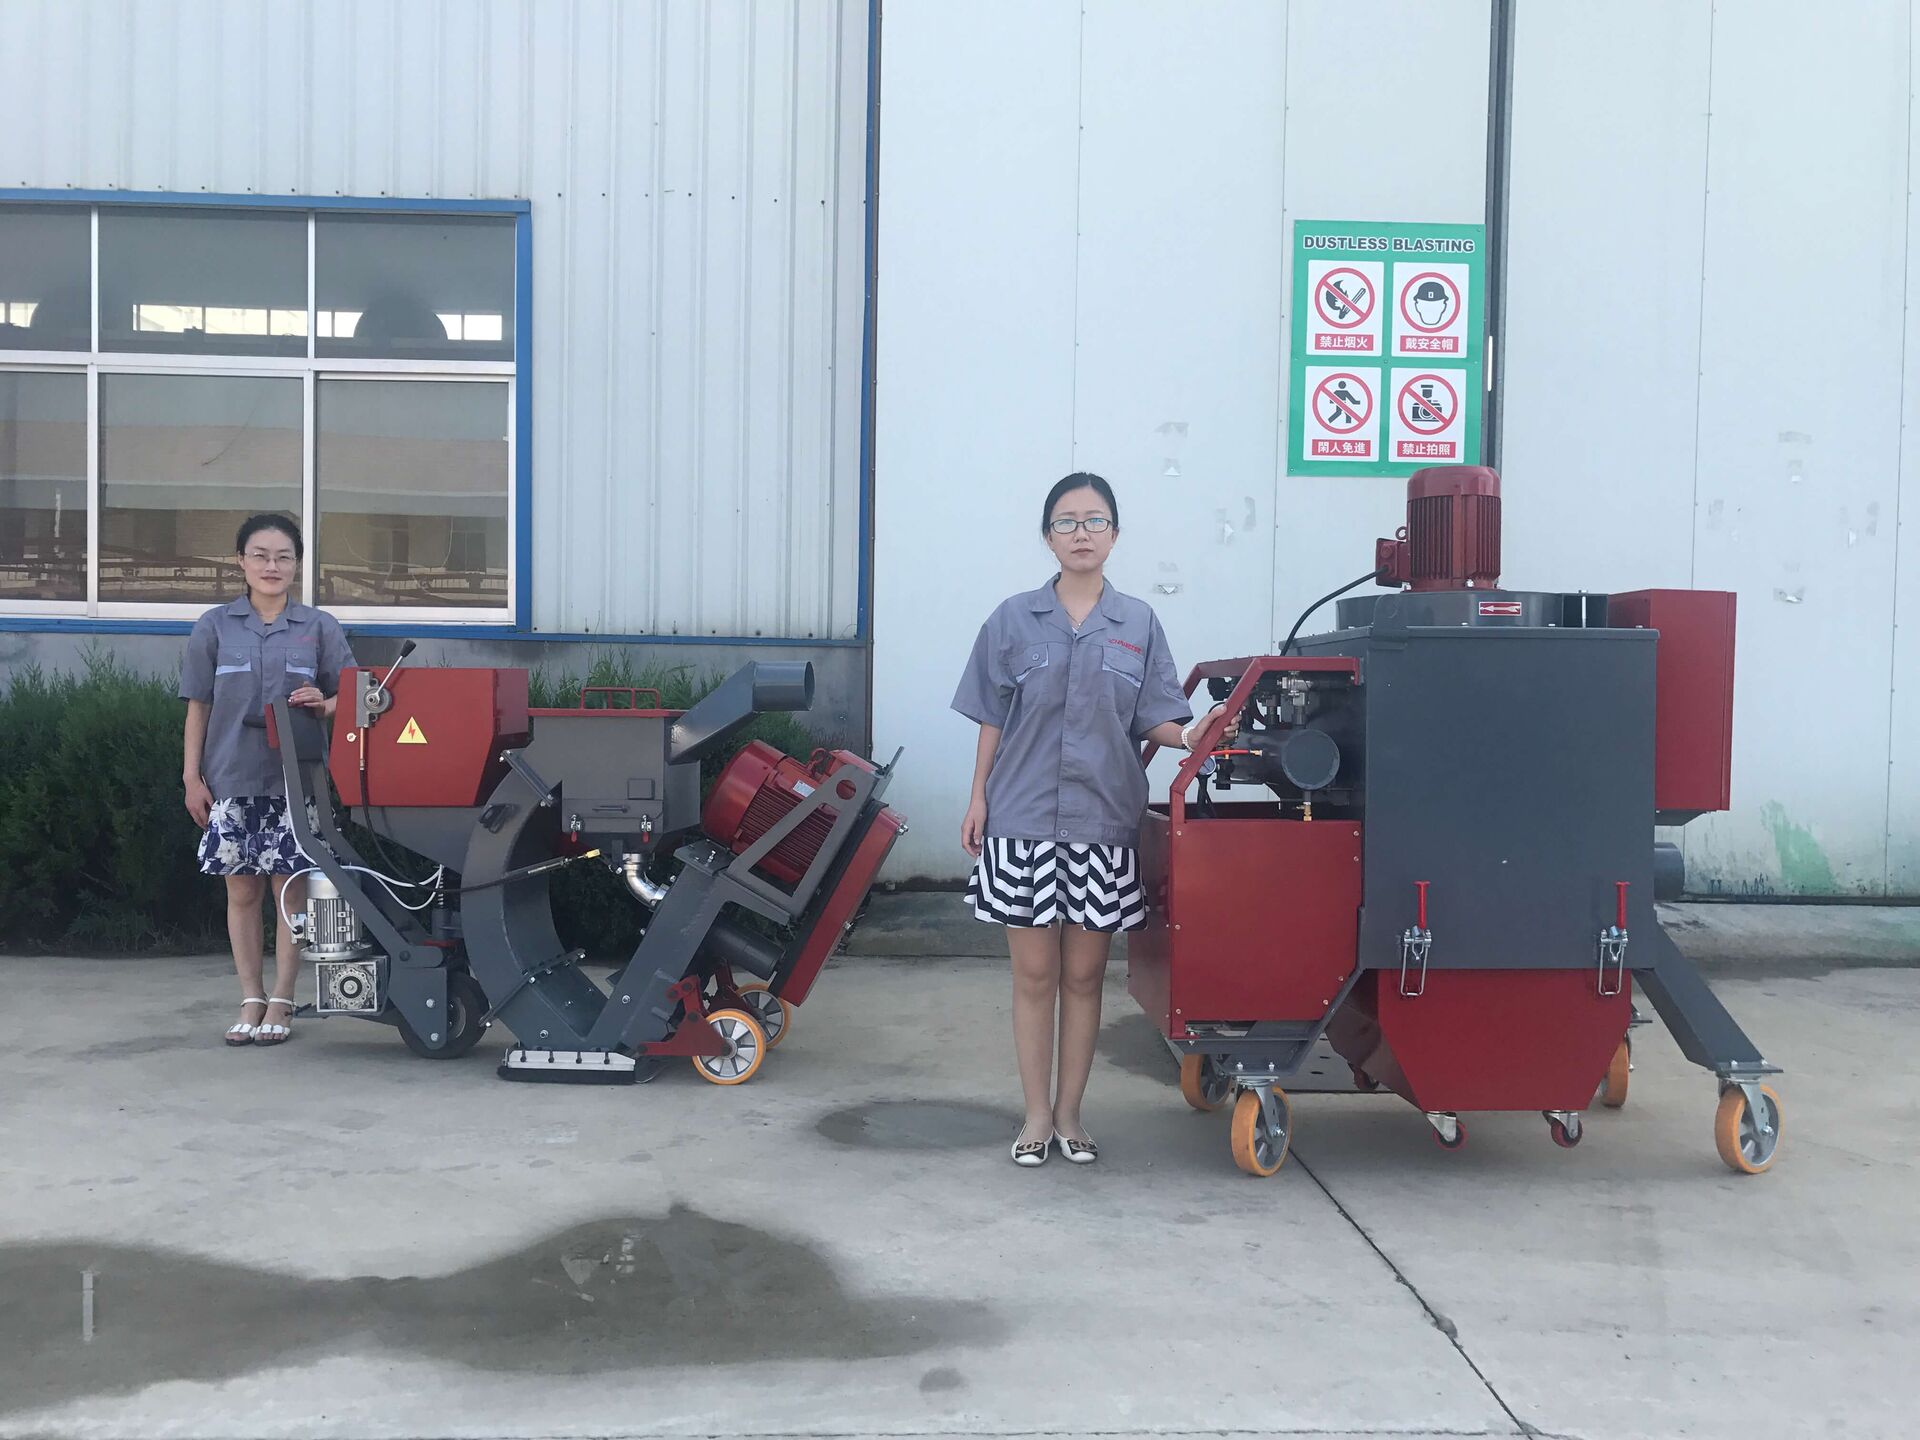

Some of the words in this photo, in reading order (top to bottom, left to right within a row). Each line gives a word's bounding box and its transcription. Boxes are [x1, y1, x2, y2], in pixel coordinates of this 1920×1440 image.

[1303, 236, 1388, 250] DUSTLESS
[1392, 237, 1475, 252] BLASTING
[1319, 335, 1368, 349] 禁止烟火
[1405, 337, 1454, 351] 戴安全帽
[1402, 442, 1451, 456] 禁止拍照
